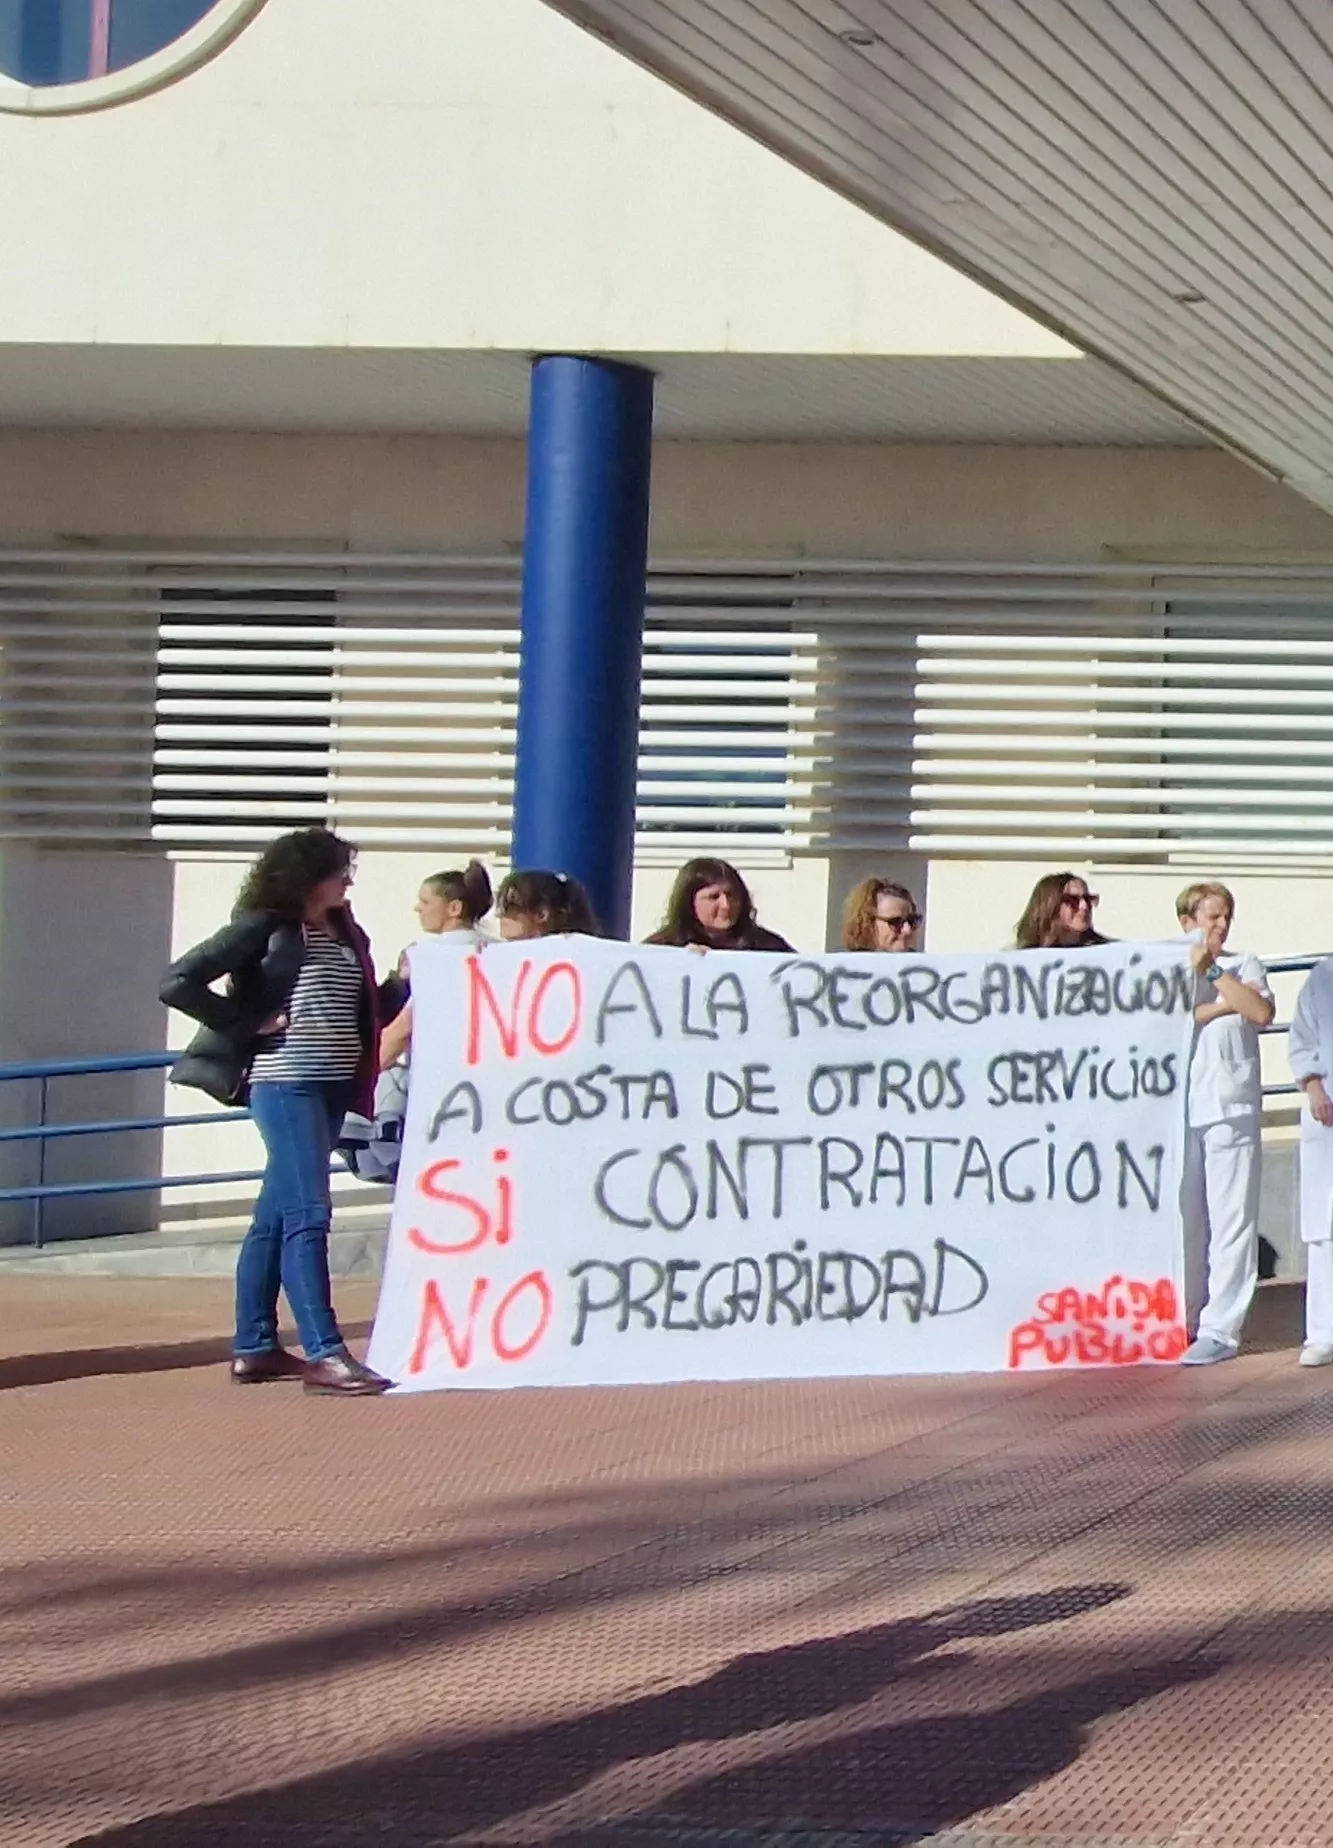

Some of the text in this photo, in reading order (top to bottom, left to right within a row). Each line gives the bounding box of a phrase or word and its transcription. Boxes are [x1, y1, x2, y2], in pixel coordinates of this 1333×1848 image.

[465, 955, 583, 1065] NO
[594, 960, 664, 1046] A
[680, 972, 749, 1041] LA
[428, 1080, 483, 1142] A
[506, 1063, 679, 1126] COSTA
[706, 1063, 780, 1120] DE
[807, 1057, 967, 1116] OTROS
[407, 1268, 554, 1375] NO
